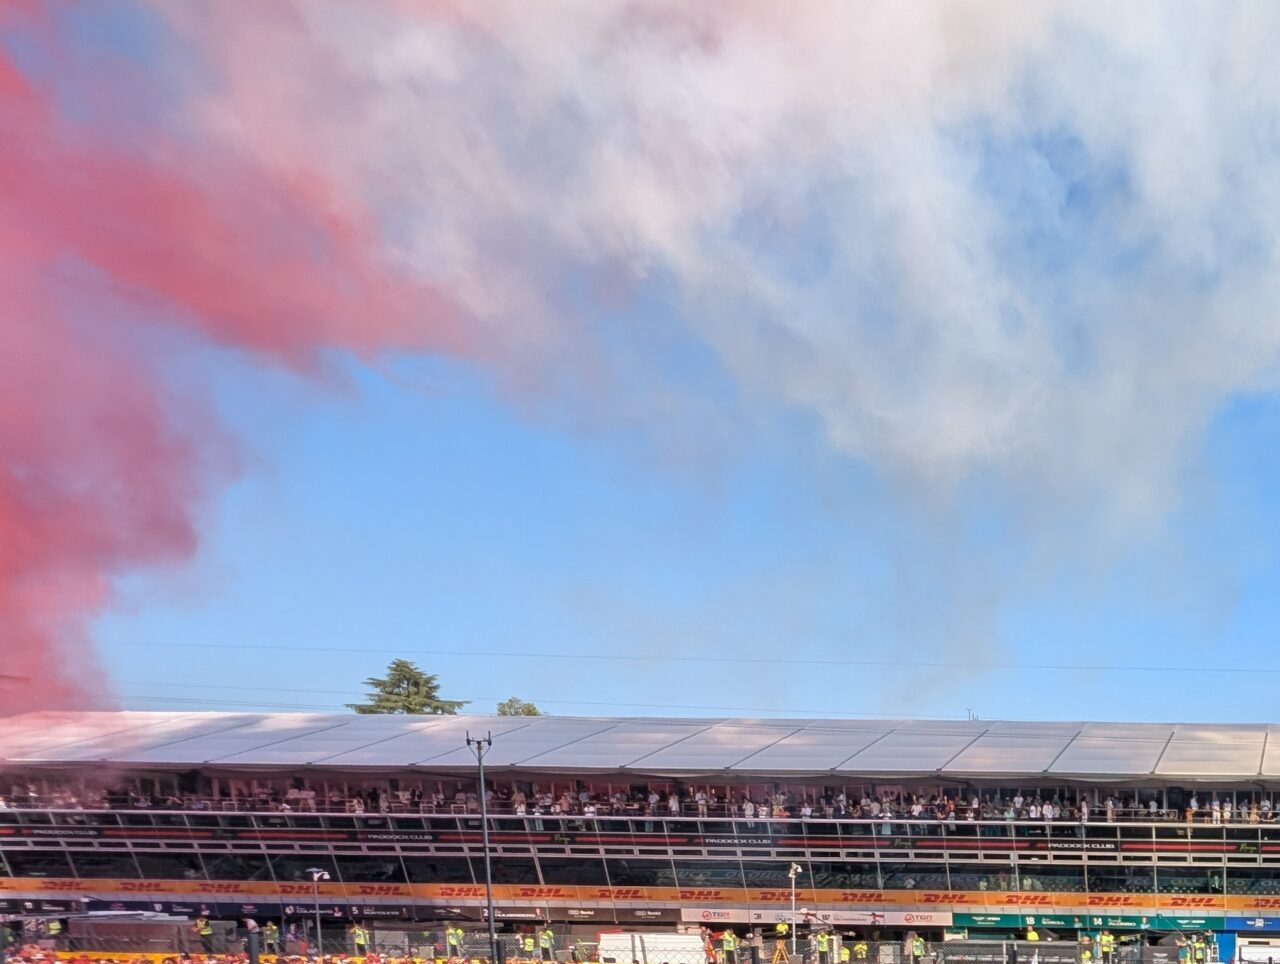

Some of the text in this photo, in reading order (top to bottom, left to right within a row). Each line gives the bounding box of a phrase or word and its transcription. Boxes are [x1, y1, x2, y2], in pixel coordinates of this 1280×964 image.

[359, 885, 405, 895] DHL
[439, 886, 486, 896] DHL
[519, 887, 566, 897] DHL
[598, 889, 643, 899] DHL
[679, 889, 724, 899] DHL
[841, 892, 885, 902] DHL
[923, 893, 969, 903] DHL
[1006, 895, 1053, 905] DHL
[1087, 896, 1135, 905] DHL
[1170, 897, 1218, 907] DHL
[352, 907, 359, 915] 5
[1025, 917, 1035, 925] 18
[1093, 918, 1103, 926] 14
